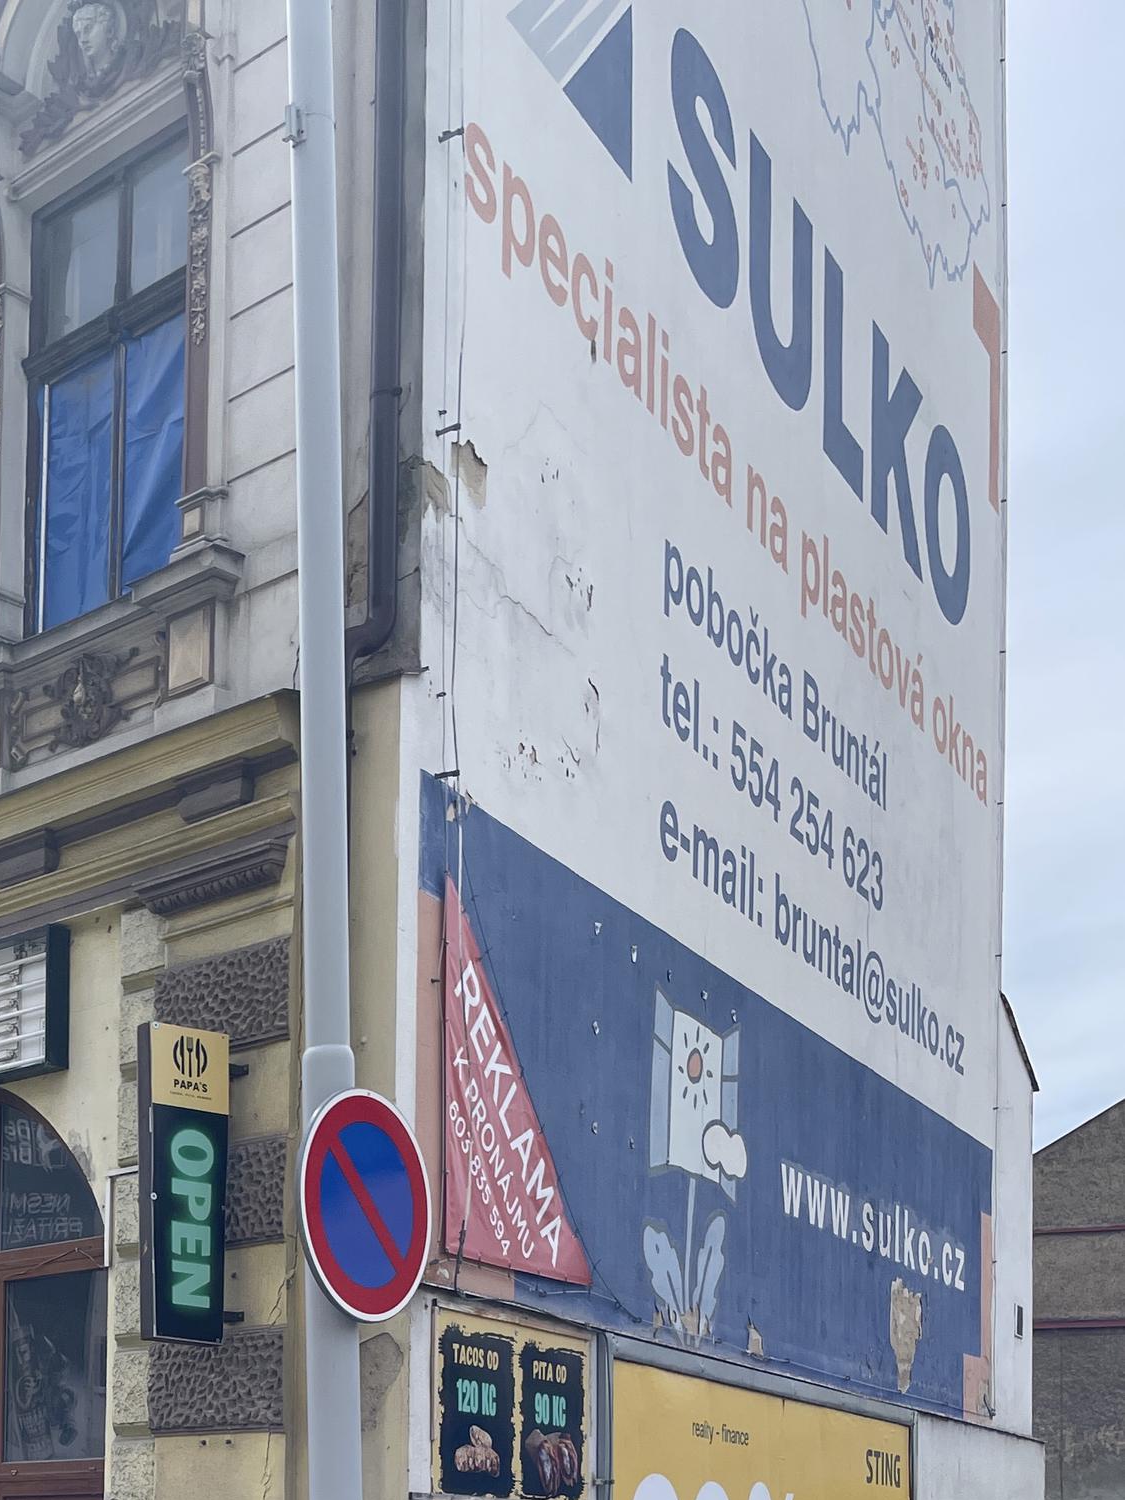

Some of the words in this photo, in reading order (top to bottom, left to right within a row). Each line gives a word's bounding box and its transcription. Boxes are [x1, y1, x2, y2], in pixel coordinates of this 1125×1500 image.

[666, 28, 970, 626] SULKO
[463, 122, 733, 507] specialista
[746, 464, 788, 573] na
[801, 530, 924, 733] plastová
[933, 695, 988, 806] okna
[664, 539, 792, 720] pobočka
[804, 677, 887, 811] Bruntál
[661, 653, 719, 771] tel.:
[731, 719, 780, 823] 554
[790, 777, 834, 869] 254
[843, 826, 885, 911] 623
[660, 800, 763, 927] e-mail:
[775, 873, 965, 1076] bruntal@sulko.cz
[173, 1079, 208, 1093] PAPA'S
[454, 959, 562, 1268] REKLAMA
[453, 1046, 469, 1081] K
[465, 1077, 535, 1259] PRONÁJMU
[470, 1155, 491, 1205] 835
[489, 1209, 511, 1257] 594
[171, 1128, 215, 1310] OPEN
[781, 1163, 966, 1292] www.sulko.cz
[452, 1343, 485, 1369] TACOS
[487, 1350, 499, 1371] OD
[456, 1378, 479, 1414] 120
[481, 1382, 497, 1416] KC
[532, 1360, 554, 1382] PITA
[555, 1364, 567, 1384] OD
[534, 1392, 550, 1425] 90
[552, 1395, 566, 1427] KC
[721, 1423, 749, 1446] finance
[865, 1449, 901, 1488] STING
